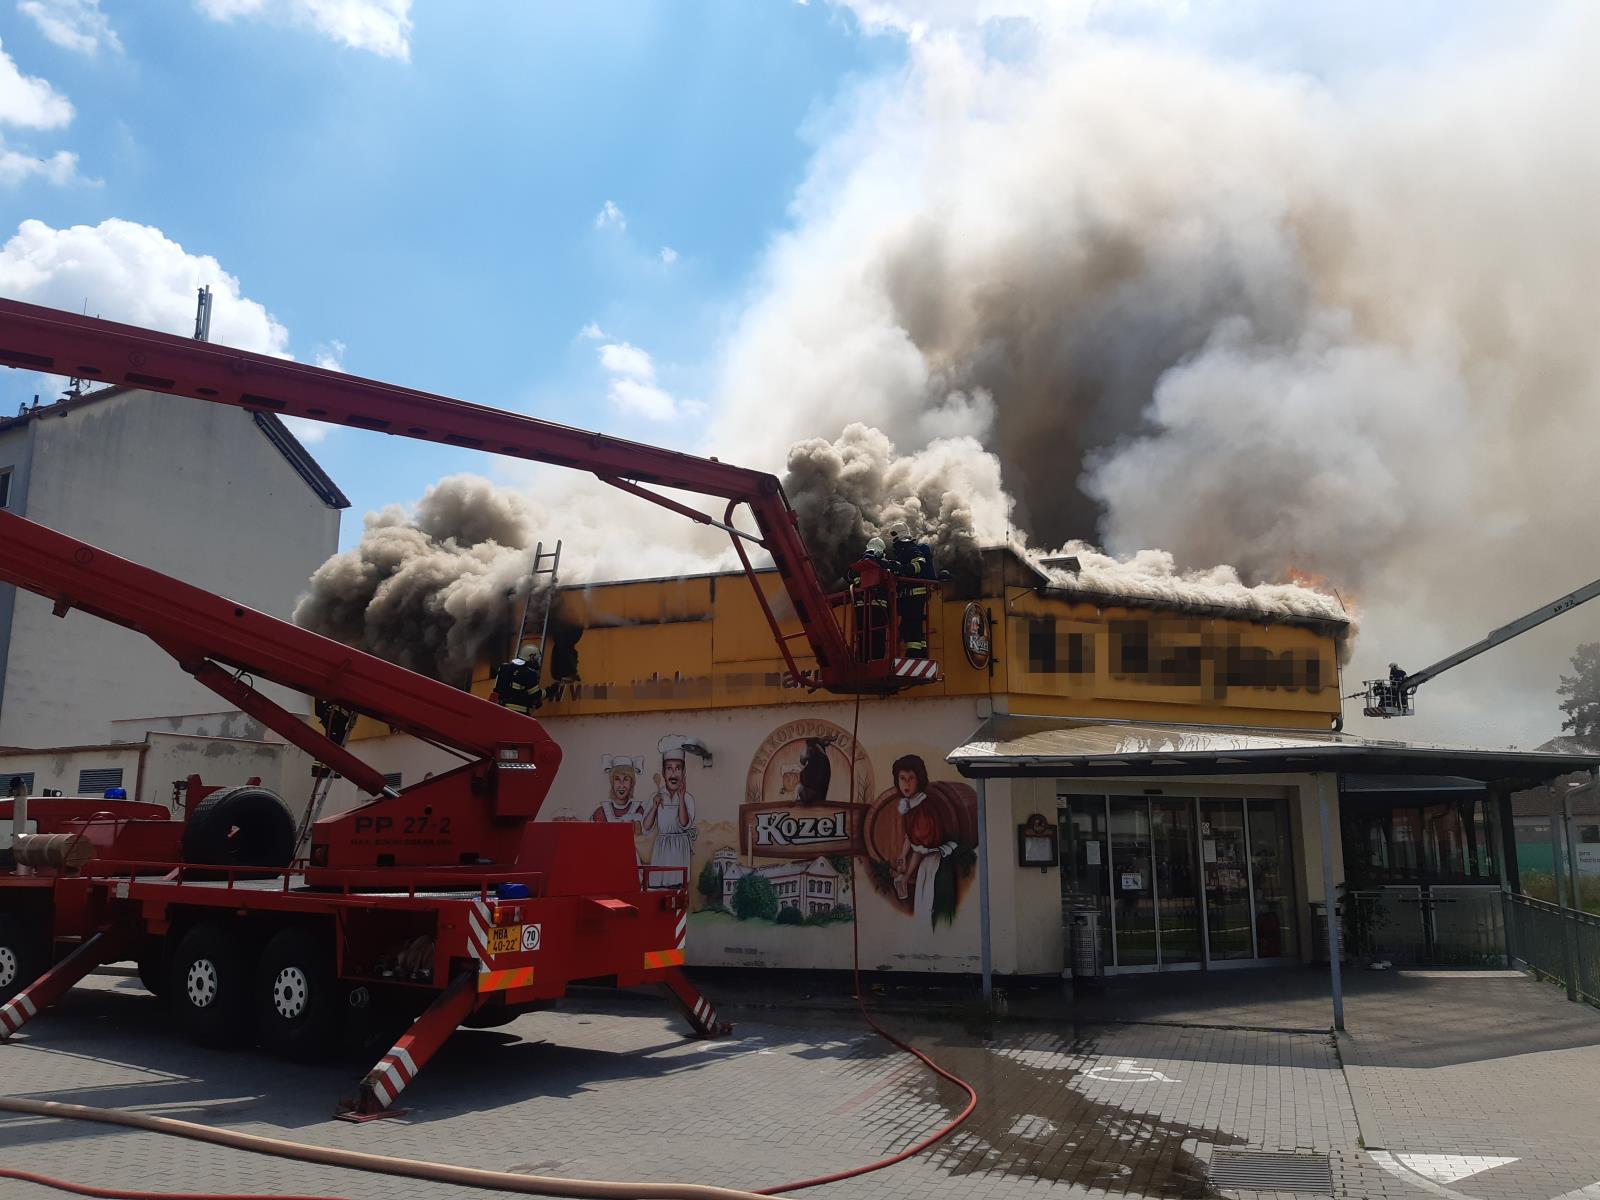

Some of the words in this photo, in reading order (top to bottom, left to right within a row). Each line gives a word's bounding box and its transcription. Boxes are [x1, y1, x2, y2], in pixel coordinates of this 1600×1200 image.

[355, 816, 393, 834] PP
[756, 811, 849, 845] Kozel
[493, 928, 508, 940] MBA
[526, 930, 536, 942] 70
[493, 939, 515, 951] 40-22
